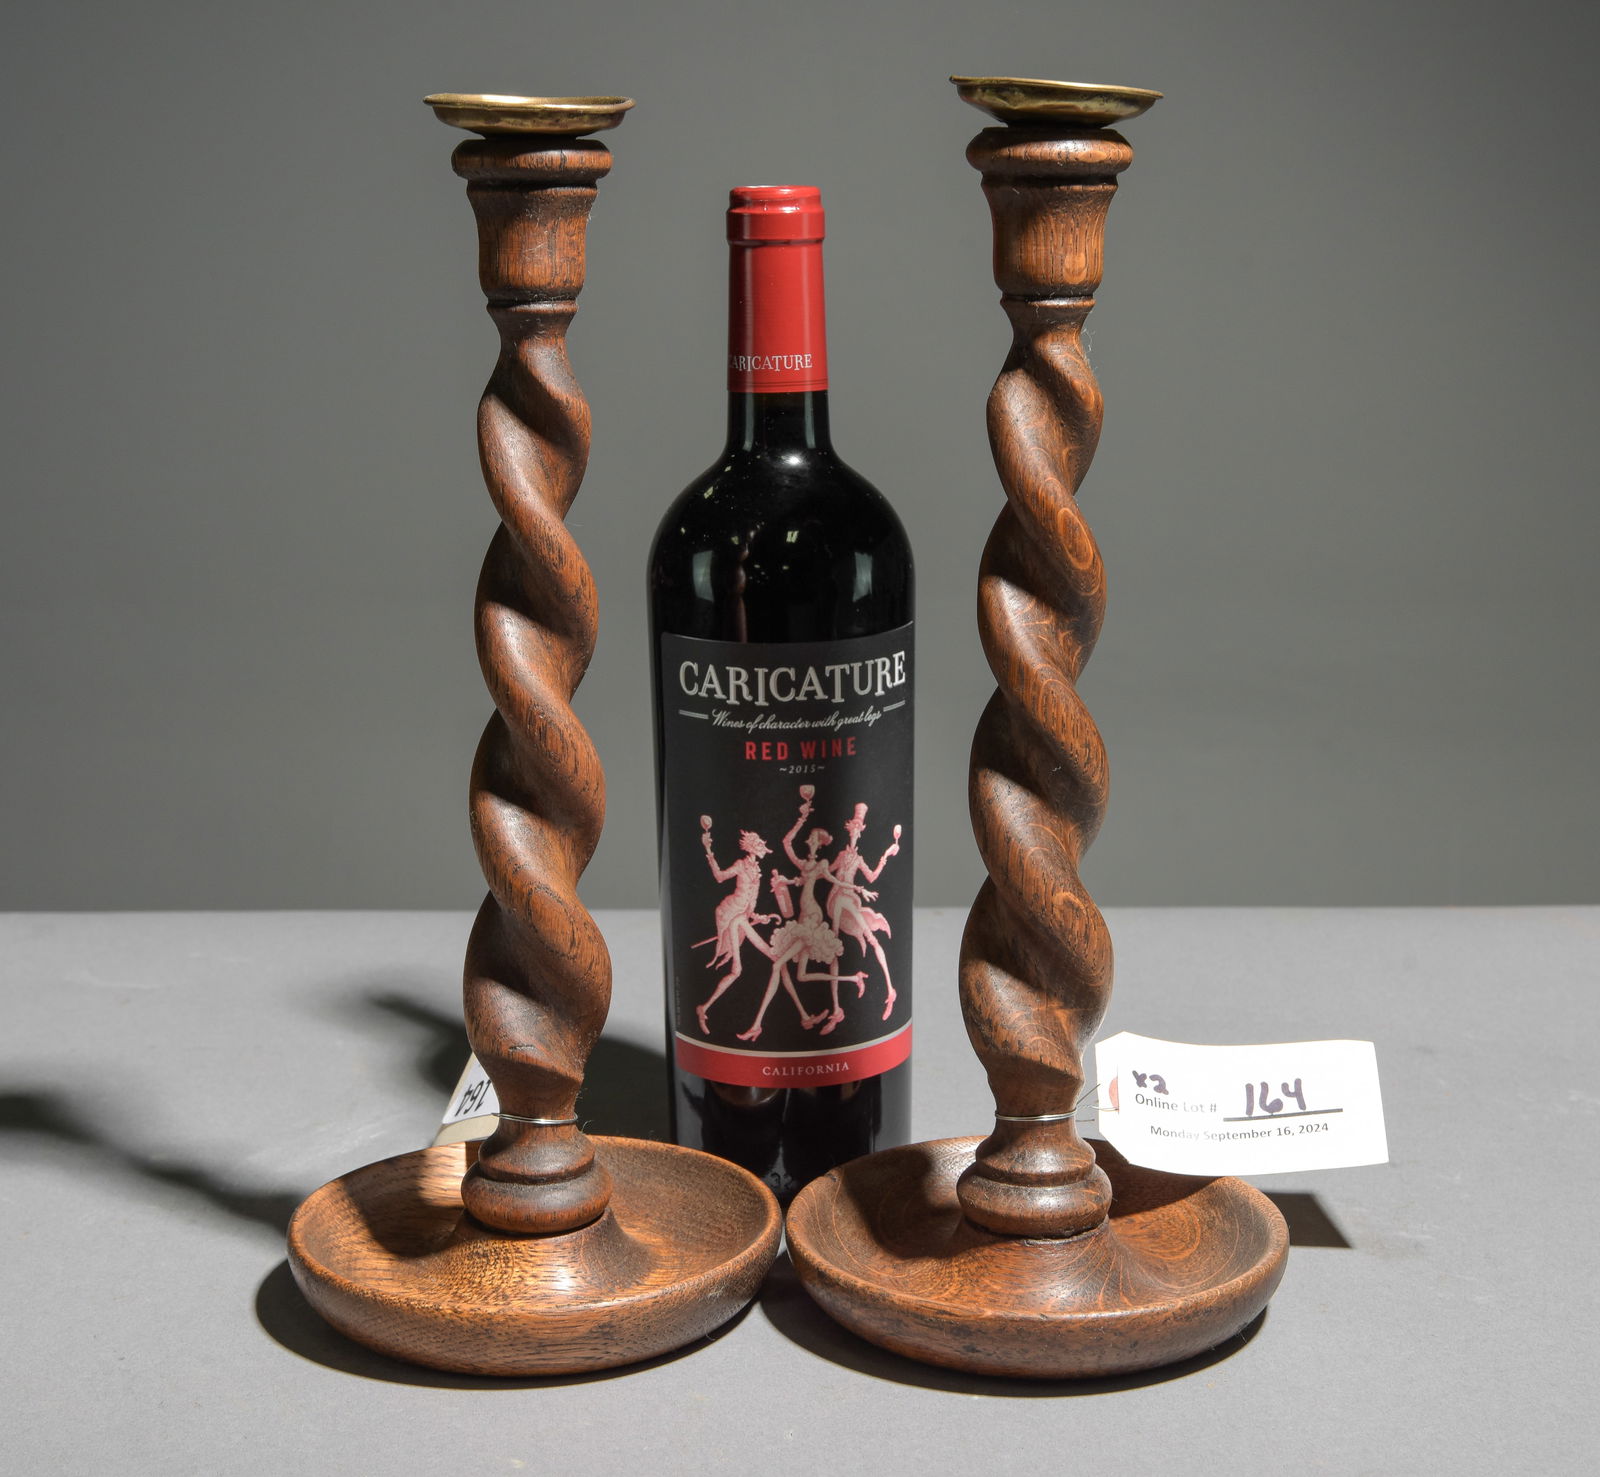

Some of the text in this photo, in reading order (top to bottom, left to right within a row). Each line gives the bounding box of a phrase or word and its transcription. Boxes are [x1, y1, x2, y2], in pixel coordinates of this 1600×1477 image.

[730, 353, 813, 371] ARICATURE
[679, 650, 906, 706] CARICATURE
[712, 705, 882, 734] Wines of character with great legs
[745, 737, 857, 760] RED WINE
[762, 1061, 850, 1077] CALIFORNIA
[1135, 1093, 1217, 1113] Online Lot #
[1245, 1078, 1307, 1116] 164
[1150, 1122, 1329, 1142] Monday September 16, 2024
